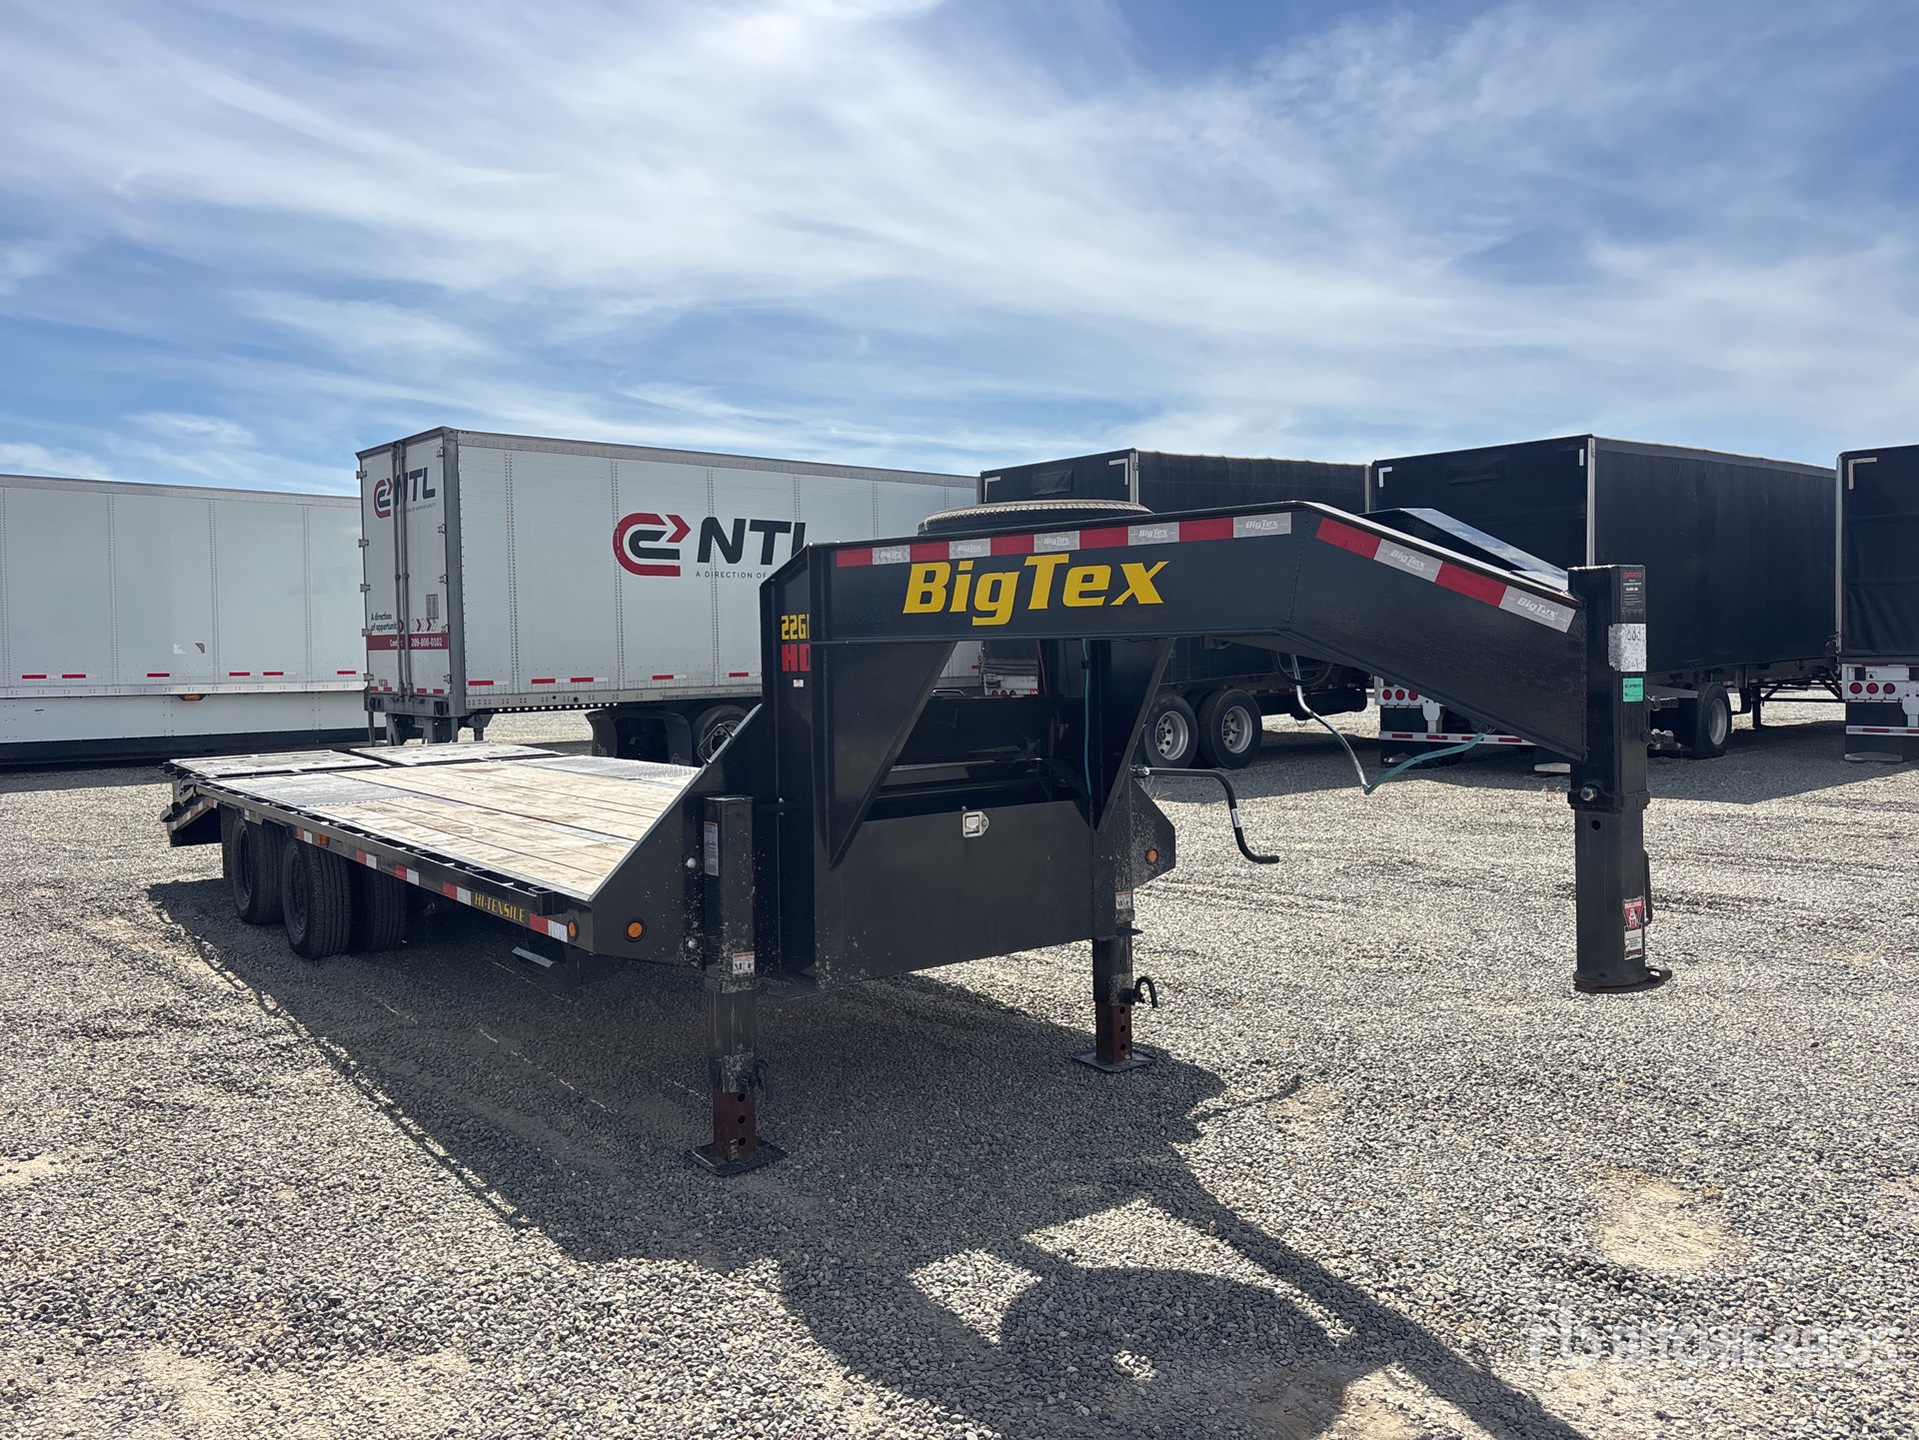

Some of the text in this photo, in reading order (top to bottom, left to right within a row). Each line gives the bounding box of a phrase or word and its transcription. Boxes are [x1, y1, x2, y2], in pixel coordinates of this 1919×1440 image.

[1390, 549, 1427, 569] BigTex
[704, 571, 753, 579] DIRECTION
[902, 553, 1170, 626] BigTex
[1516, 597, 1558, 619] BigTex
[474, 892, 526, 923] HI-TENSILE
